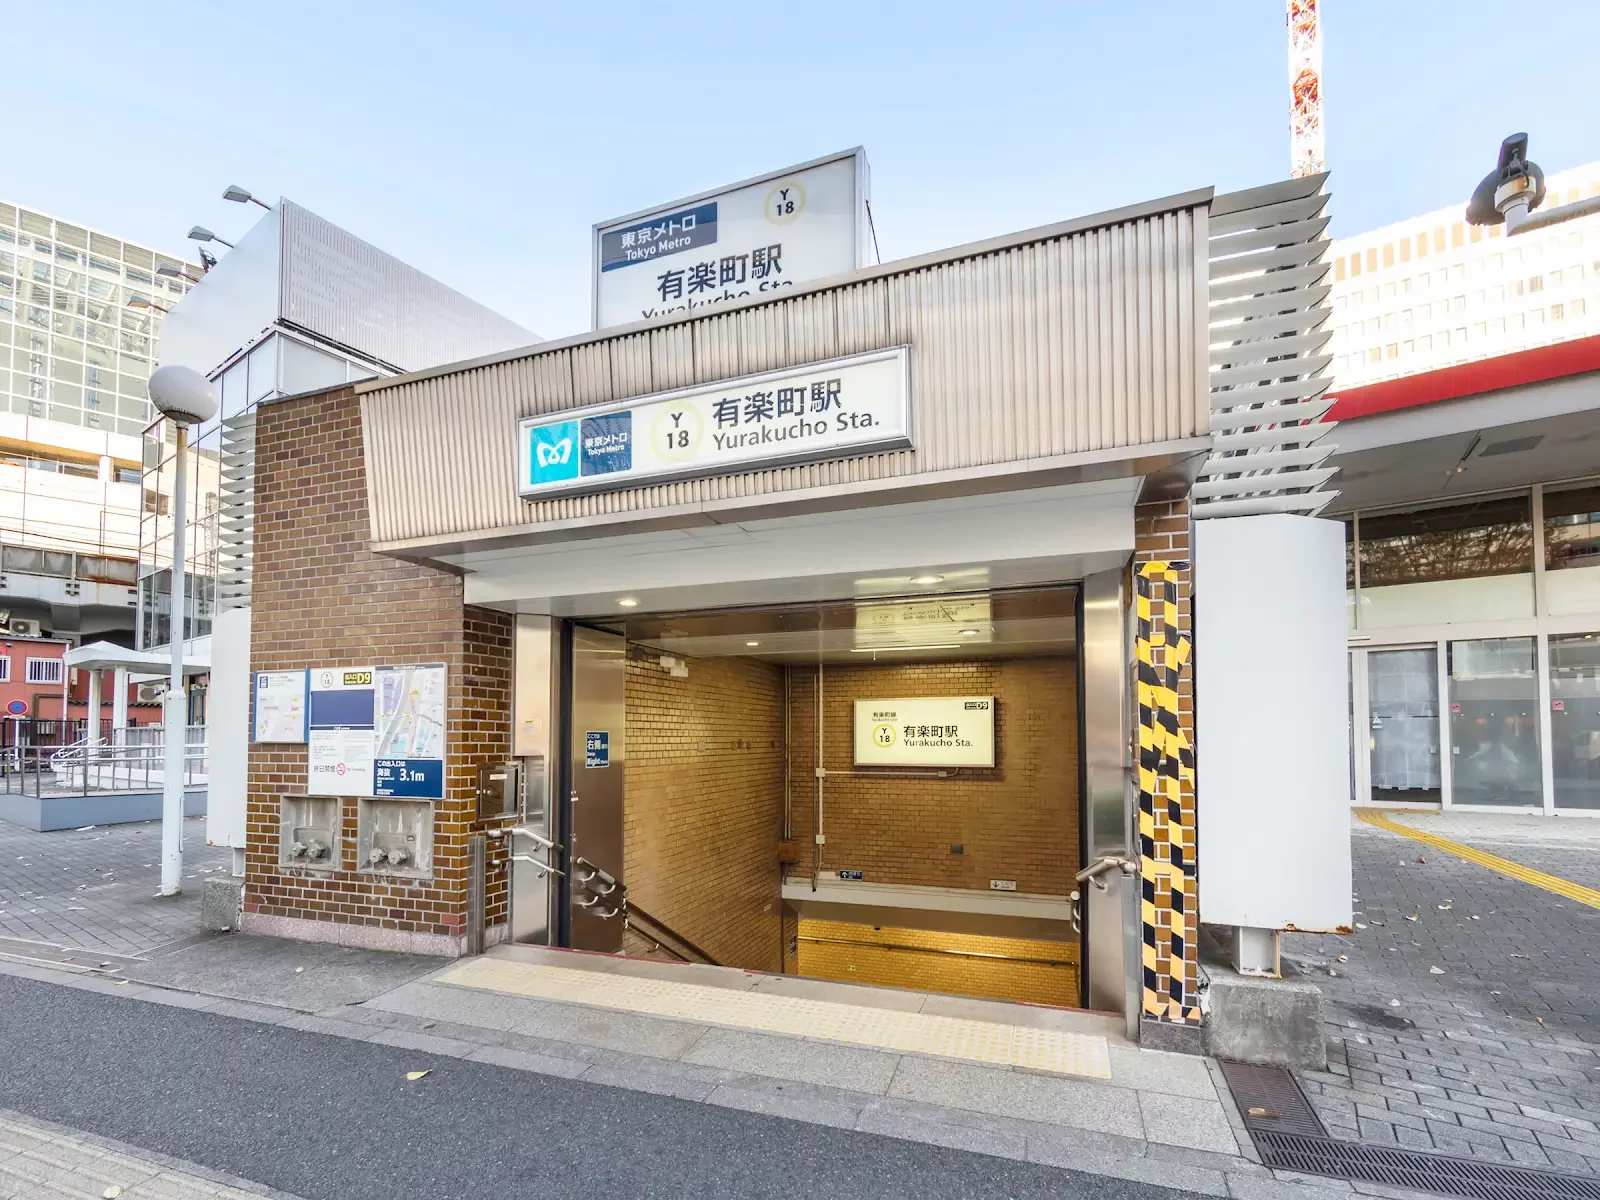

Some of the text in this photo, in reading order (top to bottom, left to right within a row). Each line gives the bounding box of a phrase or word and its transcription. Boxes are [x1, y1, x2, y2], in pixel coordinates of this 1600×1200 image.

[780, 188, 790, 200] Y
[776, 201, 795, 216] 18
[620, 214, 696, 249] 東京メトロ
[625, 235, 691, 261] Tokyo Metro
[657, 243, 783, 302] 有楽町駅
[712, 378, 842, 430] 有楽町駅
[670, 412, 683, 428] Y
[712, 410, 881, 451] Yurakucho Sta.
[585, 432, 628, 449] 東京メトロ
[667, 430, 689, 450] 18
[588, 444, 625, 456] Tokyo Metro
[357, 672, 371, 684] D9
[879, 735, 890, 743] 18
[903, 725, 958, 738] 有楽町駅
[903, 738, 973, 747] Yurakucho Sta.
[587, 757, 600, 766] Right
[399, 768, 425, 782] 3.1m
